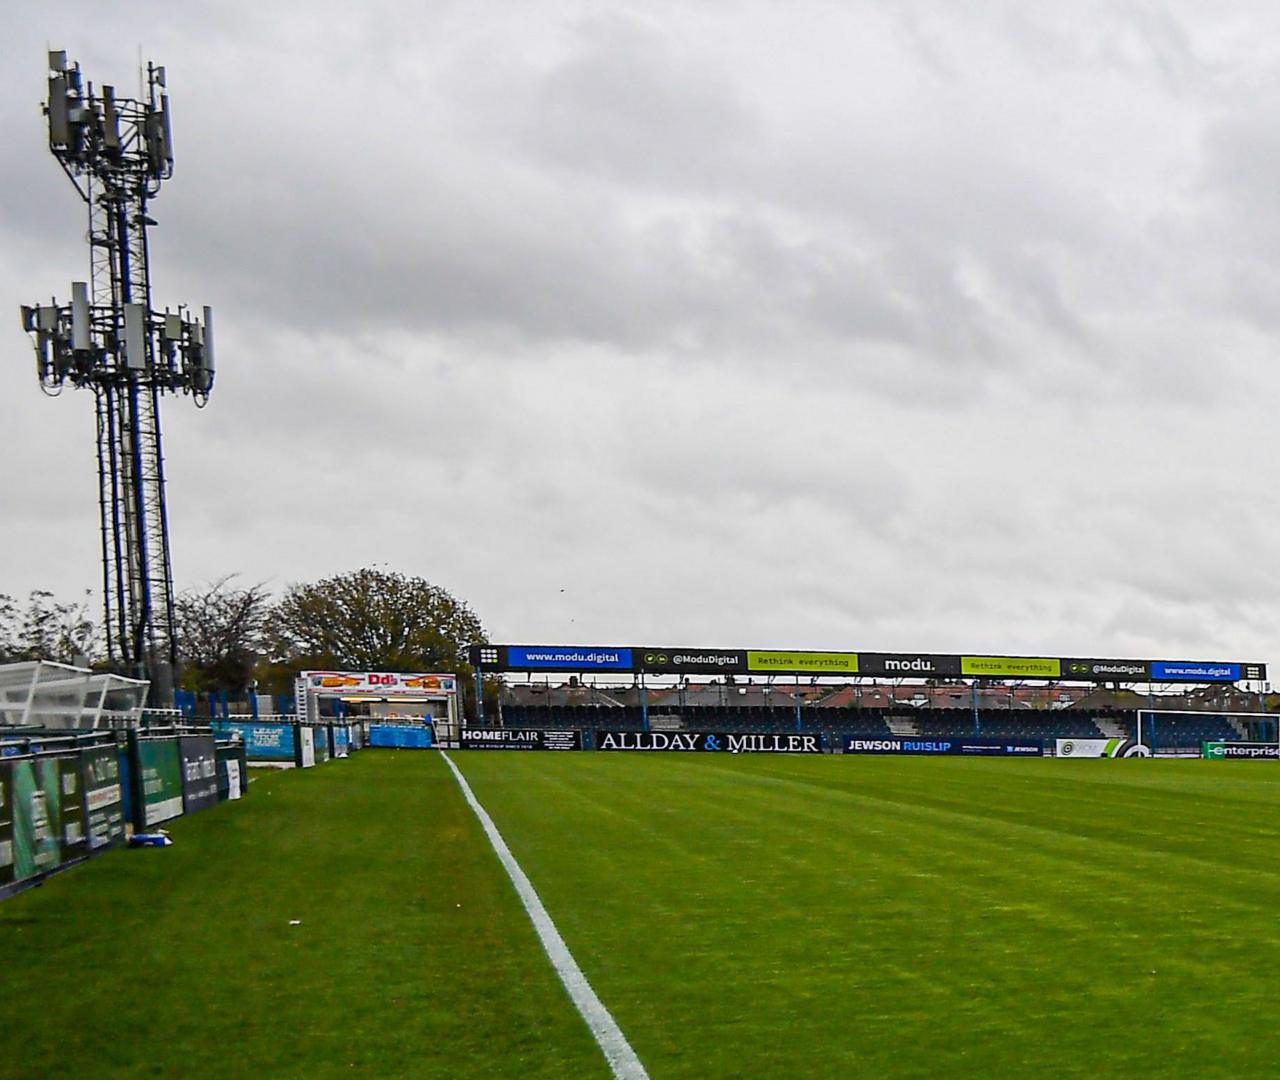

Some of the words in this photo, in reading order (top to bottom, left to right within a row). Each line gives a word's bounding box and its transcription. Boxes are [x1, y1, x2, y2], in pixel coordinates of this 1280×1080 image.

[526, 653, 619, 664] www.modu.digital
[672, 655, 739, 665] @ModuDigital
[799, 659, 849, 667] everything
[885, 658, 935, 671] modu.
[1165, 666, 1231, 676] www.modu.digital
[461, 731, 539, 741] HOMEFLAIR
[600, 733, 700, 750] ALLDAY
[704, 734, 721, 750] &
[727, 735, 819, 752] MILLER
[848, 740, 900, 750] JEWSON
[903, 741, 951, 751] RUISLIP
